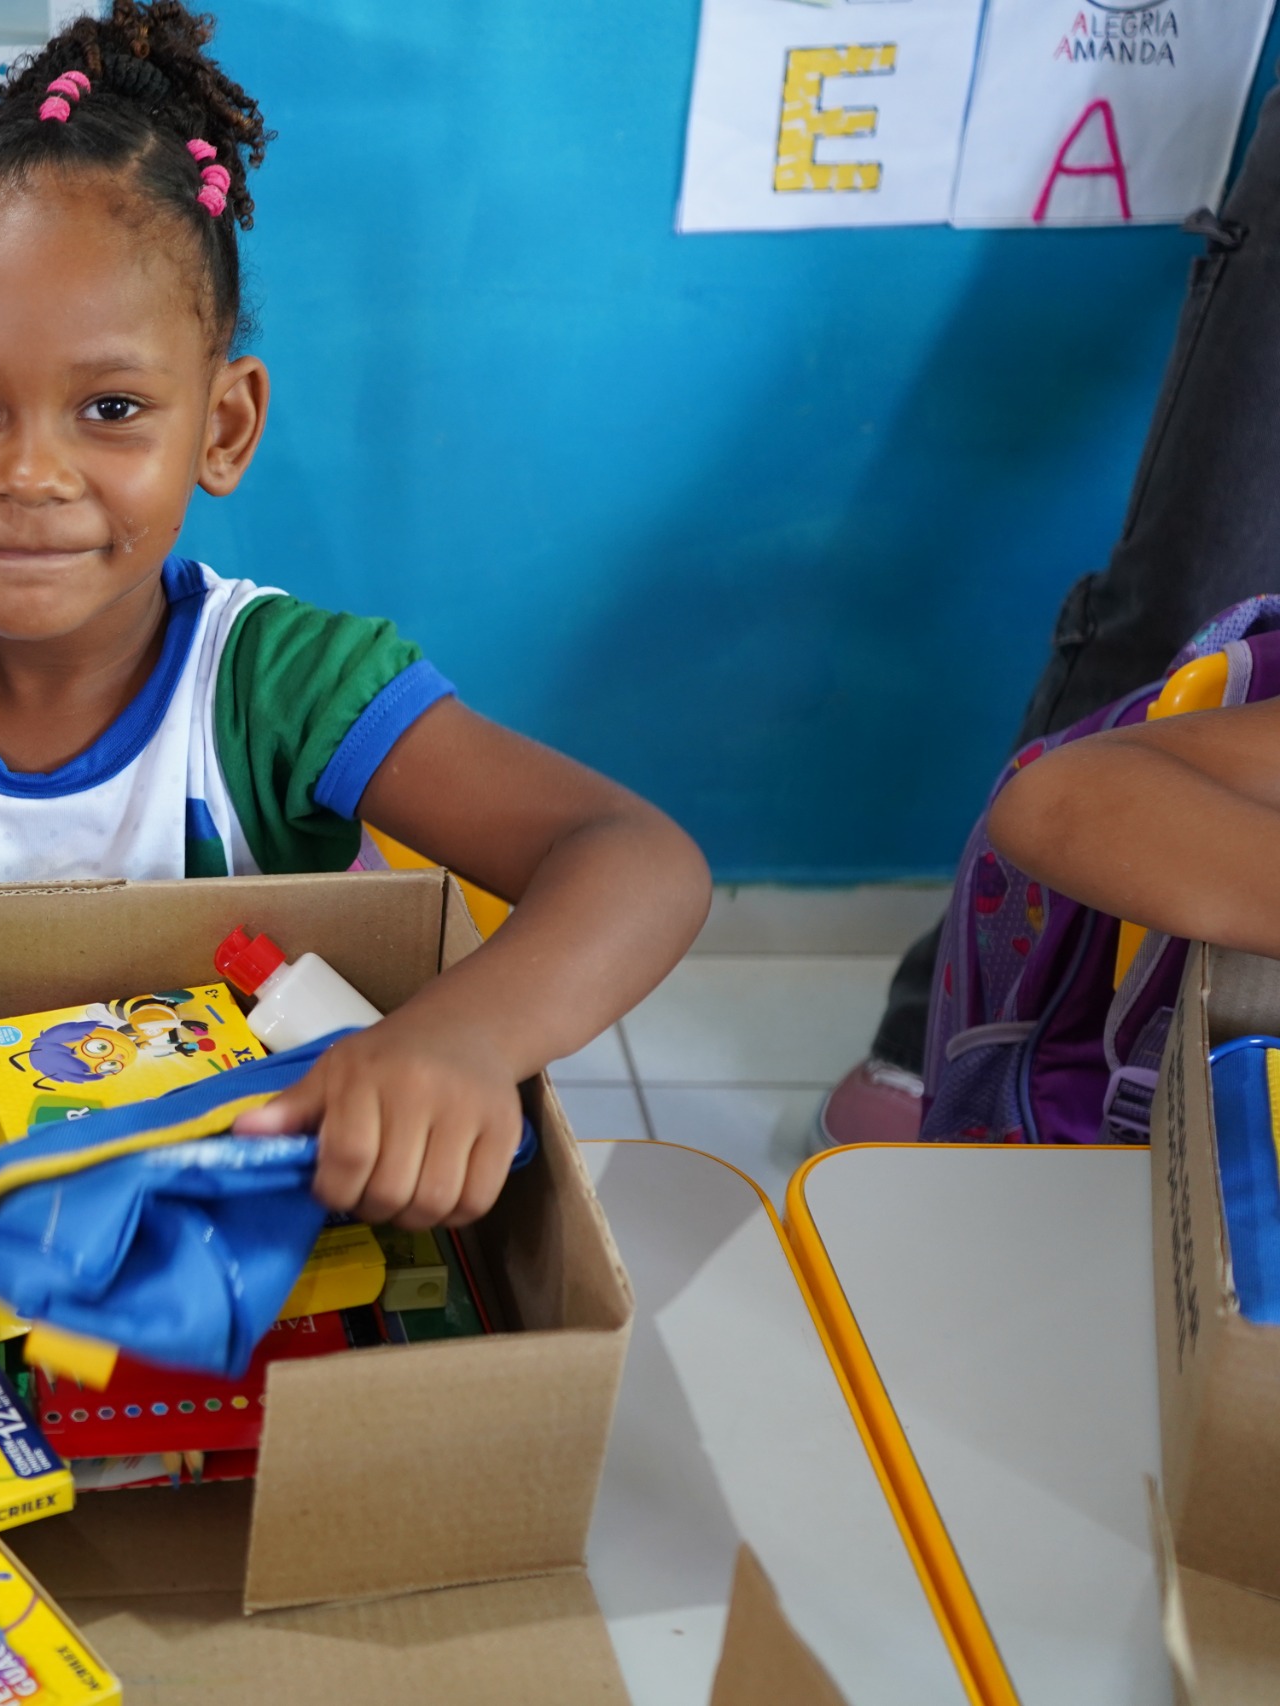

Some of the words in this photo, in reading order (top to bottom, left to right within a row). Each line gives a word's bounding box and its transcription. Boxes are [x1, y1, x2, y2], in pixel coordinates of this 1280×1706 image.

[1053, 34, 1175, 67] AMANDA
[1071, 8, 1178, 38] ALEGRIA
[773, 42, 897, 193] E
[1032, 97, 1133, 223] A
